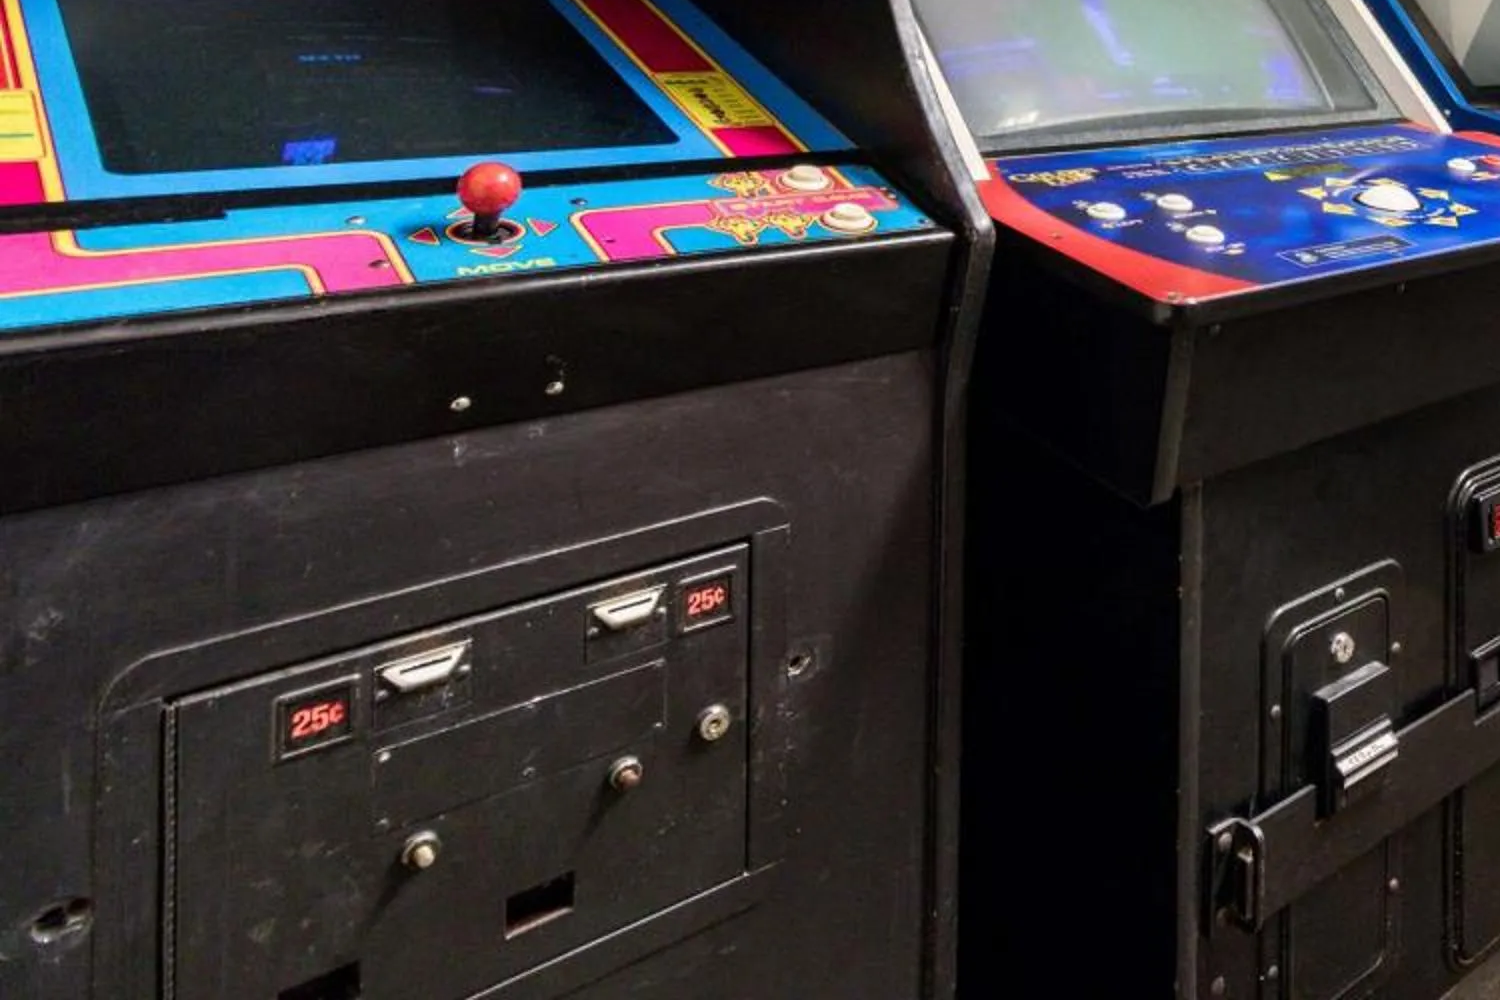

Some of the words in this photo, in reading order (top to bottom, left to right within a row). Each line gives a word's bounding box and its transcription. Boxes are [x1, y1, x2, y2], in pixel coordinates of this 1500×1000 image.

[457, 257, 555, 276] MOVE
[688, 587, 725, 616] 25¢
[290, 700, 345, 739] 25¢
